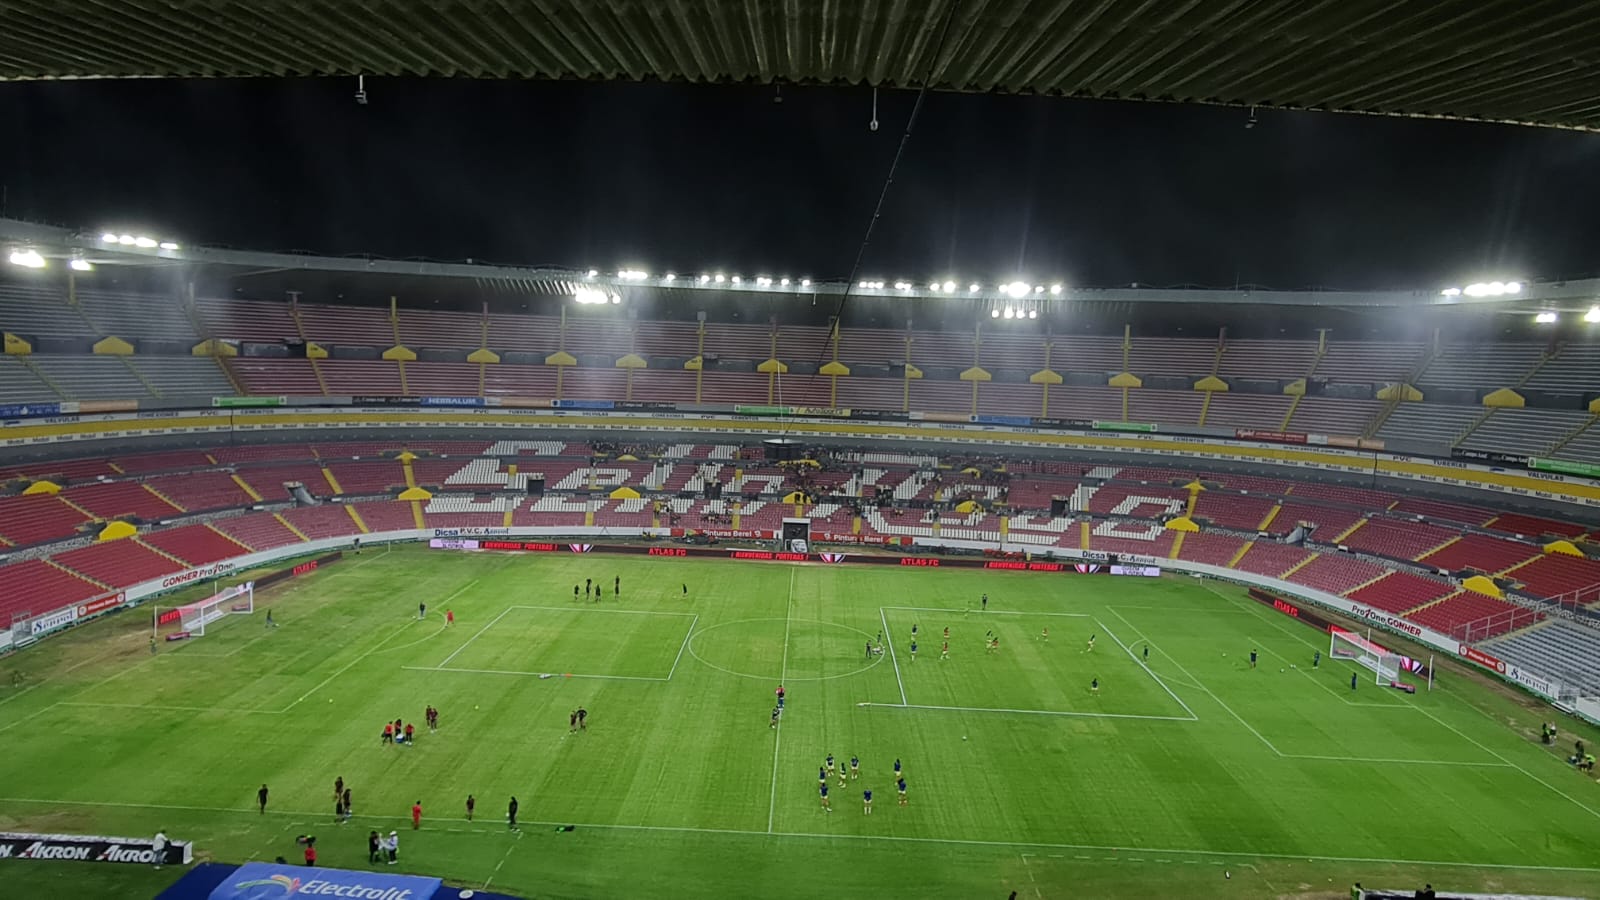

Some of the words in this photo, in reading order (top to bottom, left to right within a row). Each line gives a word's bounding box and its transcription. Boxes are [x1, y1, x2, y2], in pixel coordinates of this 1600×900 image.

[833, 534, 863, 542] Pinturs
[648, 548, 674, 556] ATLAS
[1082, 550, 1105, 559] Dicsa
[900, 558, 927, 566] ATLAS
[162, 567, 198, 588] GONHER
[1387, 618, 1422, 637] GONHER
[17, 841, 91, 860] AKRON
[298, 880, 413, 900] Electrolit
